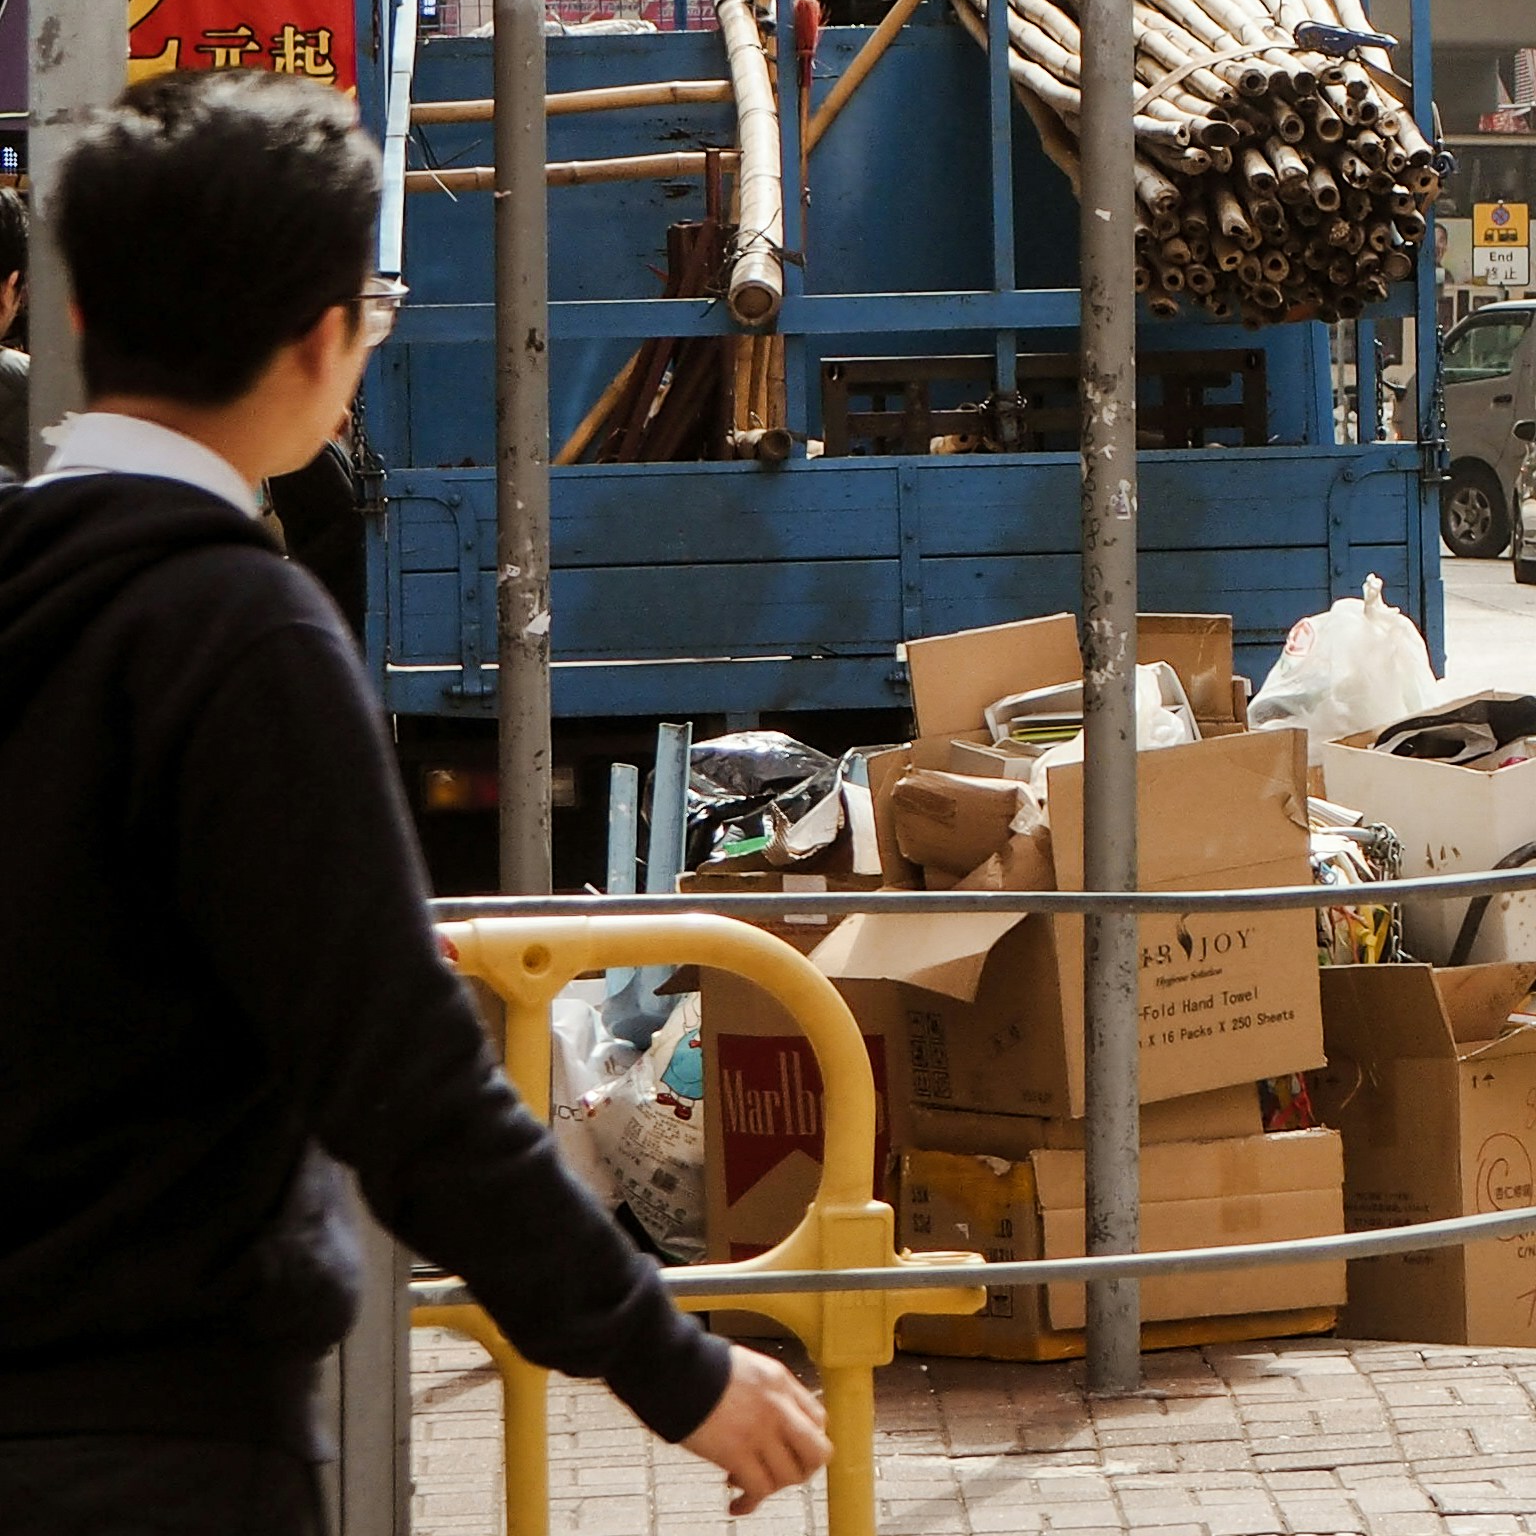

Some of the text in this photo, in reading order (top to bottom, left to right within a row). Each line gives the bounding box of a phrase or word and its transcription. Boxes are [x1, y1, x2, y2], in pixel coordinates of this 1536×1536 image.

[1489, 251, 1514, 263] End
[1198, 928, 1252, 963] JOY
[1138, 986, 1259, 1022] -Fold Hand Towel
[1162, 1031, 1175, 1044] 16
[1180, 1025, 1213, 1040] Packs
[1218, 1020, 1226, 1033] X
[1231, 1015, 1252, 1031] 250
[1256, 1008, 1296, 1026] Sheets
